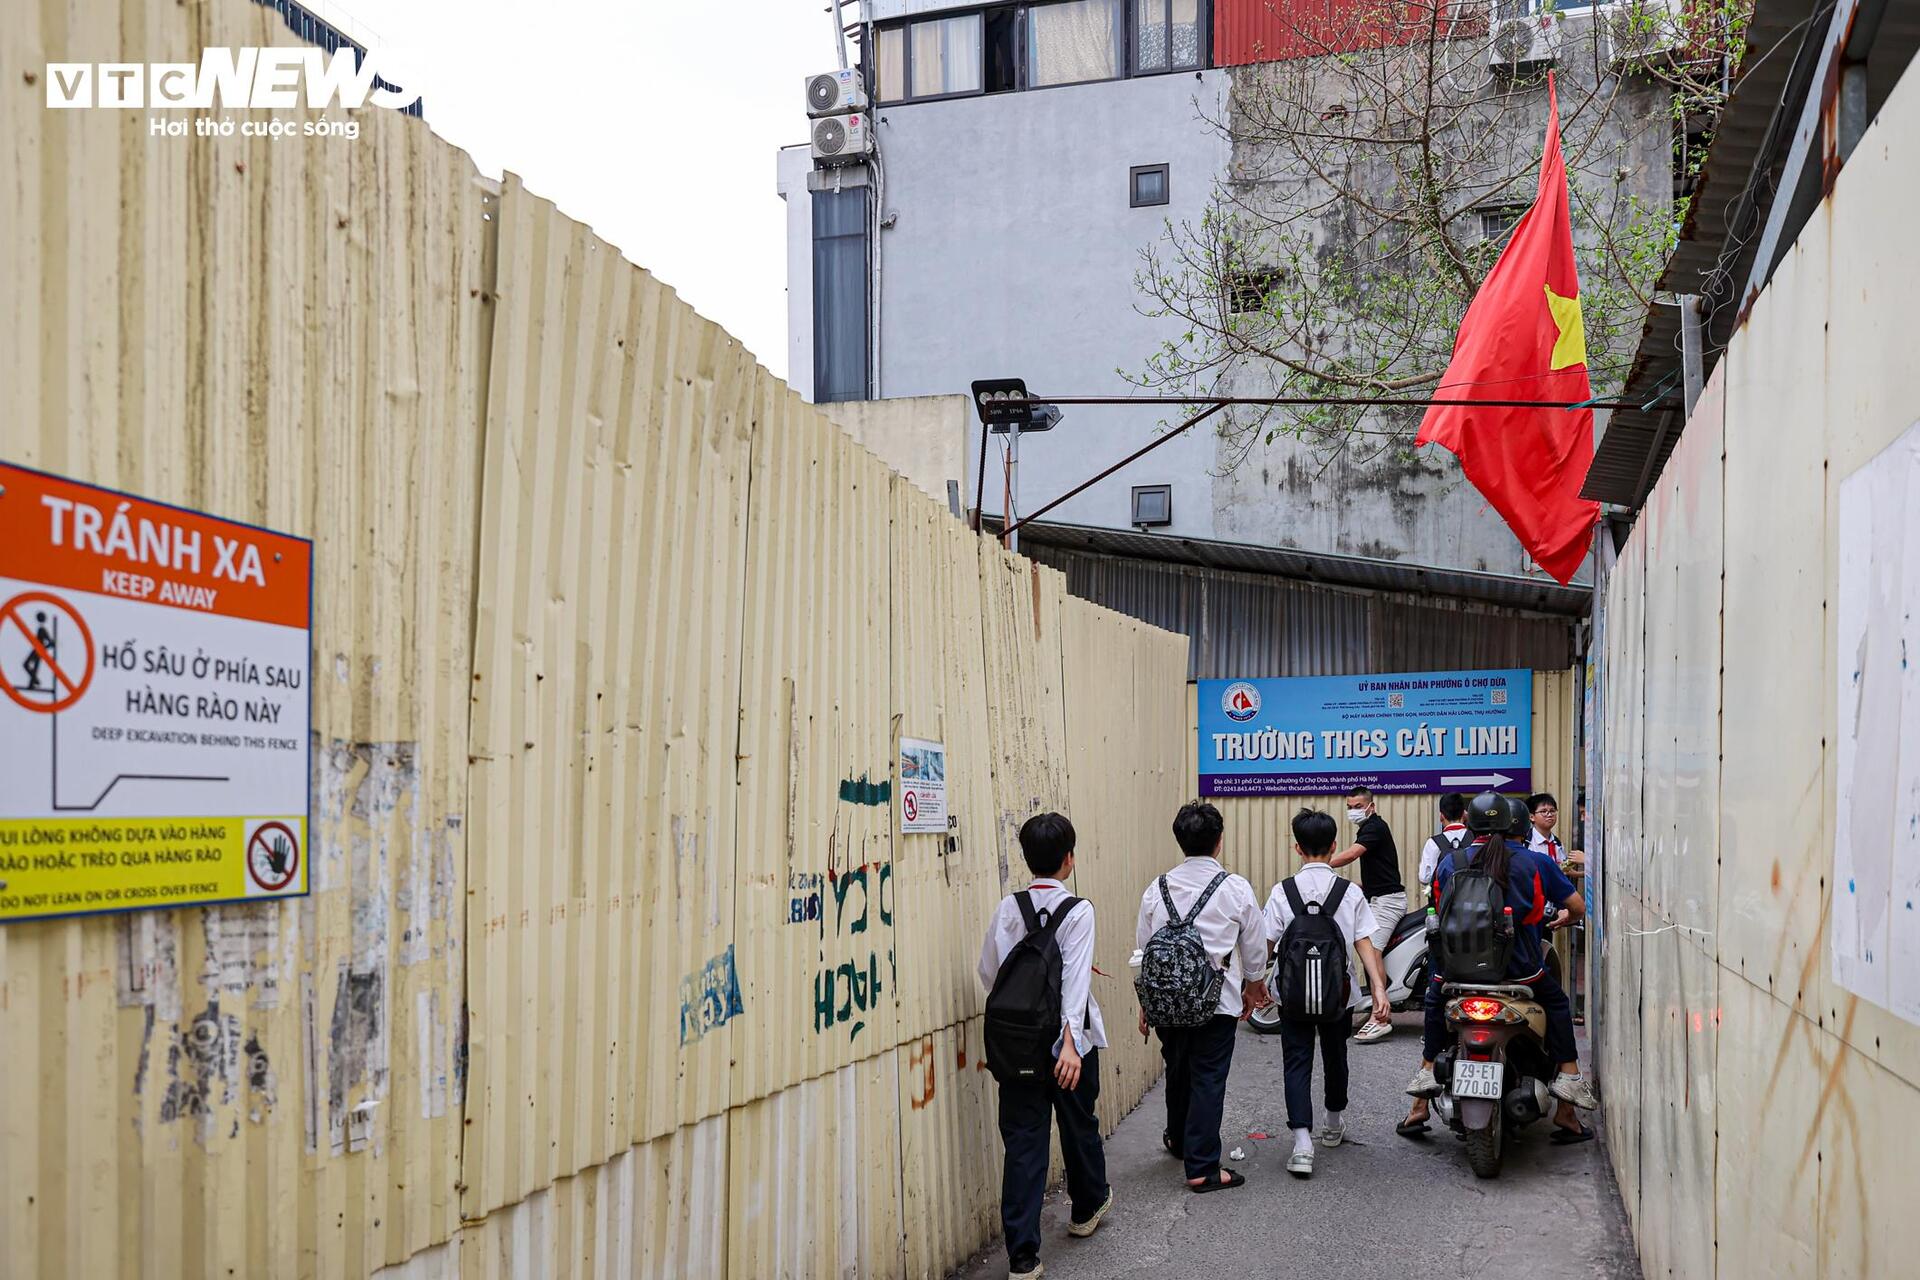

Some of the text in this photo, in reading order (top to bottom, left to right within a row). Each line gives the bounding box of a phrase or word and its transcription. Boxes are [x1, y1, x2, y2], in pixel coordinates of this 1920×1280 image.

[41, 496, 266, 587] TRÁNH XA
[102, 569, 218, 610] KEEP AWAY
[102, 638, 301, 690] HỐ SÂU Ở PHÍA SAU
[1370, 682, 1387, 692] BAN
[1388, 680, 1410, 690] NHÂN
[1412, 680, 1428, 690] DÂN
[1430, 678, 1462, 689] PHƯỜNG
[1472, 678, 1488, 688] CHỢ
[126, 684, 282, 724] HÀNG RÀO NÀY
[92, 726, 298, 750] DEEP EXCAVATION BEHIND THIS FENCE
[1212, 722, 1519, 760] TRƯỜNG THCS CÁT LINH
[22, 826, 65, 846] LÒNG
[70, 826, 122, 843] KHÔNG
[126, 828, 156, 844] DỰA
[160, 825, 187, 841] VÀO
[190, 824, 226, 840] HÀNG
[33, 852, 76, 872] HOẶC
[80, 850, 118, 868] TRÈO
[120, 852, 152, 867] QUA
[155, 846, 192, 864] HÀNG
[196, 846, 222, 862] RÀO
[1, 882, 218, 909] DO NOT LEAN ON OR CROSS OVER FENCE
[1460, 1064, 1496, 1079] 29-E1
[1456, 1079, 1499, 1096] 770.06
